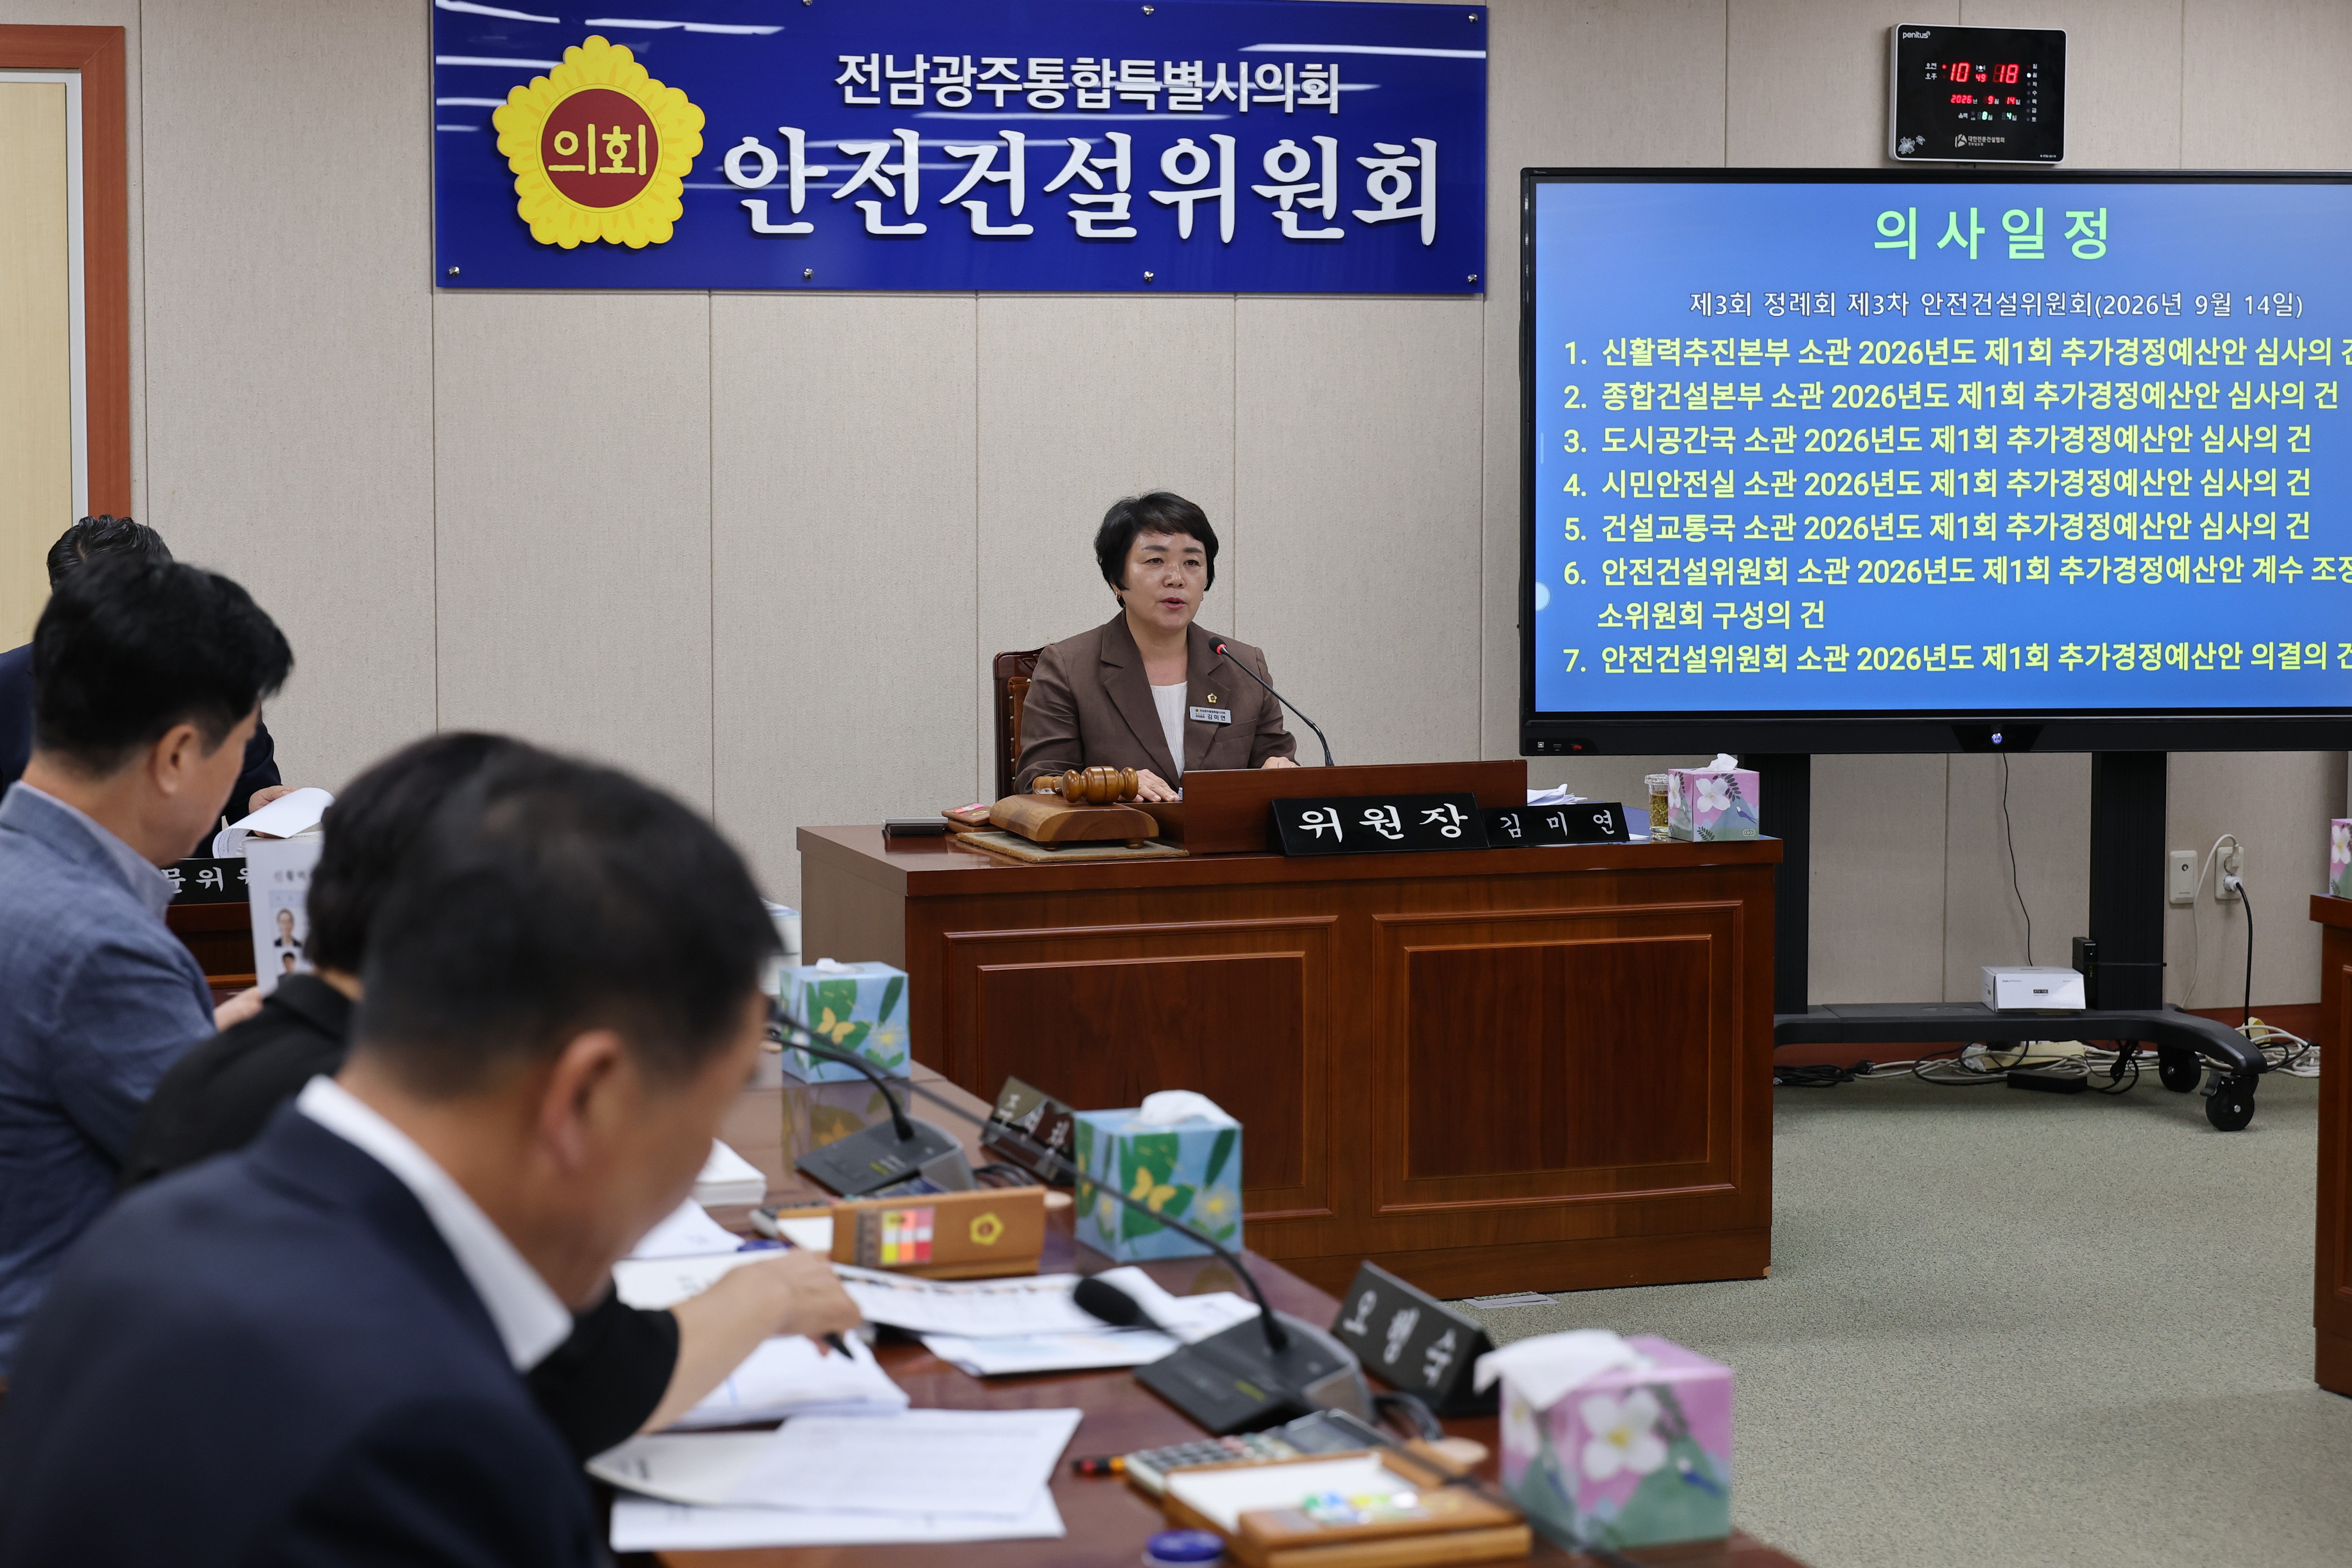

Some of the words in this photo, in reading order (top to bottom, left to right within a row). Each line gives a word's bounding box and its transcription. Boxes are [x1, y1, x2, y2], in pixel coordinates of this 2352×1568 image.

[1903, 31, 1928, 39] penitus
[834, 53, 1340, 114] 전남광주통합특별시의회
[1950, 62, 1971, 82] 10
[1975, 73, 1987, 83] 49
[1999, 64, 2019, 83] 18
[549, 123, 648, 176] 의회
[724, 126, 1438, 247] 안전건설위원회
[1874, 207, 2107, 260] 의사일정
[1690, 292, 1751, 317] 제3회
[1764, 292, 1835, 317] 정례회
[1848, 292, 1909, 317] 제3차
[1921, 292, 2181, 319] 안전건설위원회(2026년
[2195, 292, 2230, 317] 9월
[2245, 292, 2303, 319] 14일)
[1564, 341, 1587, 365] 1.
[1602, 337, 1790, 367] 신활력추진본부
[1798, 337, 1851, 366] 소관
[1859, 337, 1977, 365] 2026년도
[1984, 337, 2051, 366] 제1회
[2061, 337, 2247, 366] 추가경정예산안
[2255, 337, 2331, 366] 심사의
[1564, 385, 1587, 409] 2.
[1602, 381, 1763, 411] 종합건설본부
[1771, 381, 1824, 410] 소관
[1831, 381, 1949, 409] 2026년도
[1957, 381, 2024, 410] 제1회
[2034, 381, 2220, 410] 추가경정예산안
[2228, 381, 2304, 410] 심사의
[2314, 381, 2337, 409] 건
[1564, 429, 1587, 453] 3.
[1602, 425, 1736, 455] 도시공간국
[1744, 425, 1797, 454] 소관
[1804, 425, 1922, 453] 2026년도
[1930, 425, 1997, 454] 제1회
[2007, 425, 2193, 454] 추가경정예산안
[2201, 424, 2277, 453] 심사의
[2287, 424, 2310, 452] 건
[1563, 473, 1587, 497] 4.
[1602, 469, 1735, 498] 시민안전실
[1744, 469, 1797, 497] 소관
[1804, 469, 1922, 497] 2026년도
[1930, 468, 1996, 497] 제1회
[2006, 468, 2192, 497] 추가경정예산안
[2200, 468, 2276, 497] 심사의
[2287, 468, 2310, 496] 건
[1564, 517, 1587, 541] 5.
[1602, 514, 1736, 543] 건설교통국
[1744, 513, 1797, 541] 소관
[1804, 513, 1922, 541] 2026년도
[1929, 512, 1996, 541] 제1회
[2006, 512, 2192, 541] 추가경정예산안
[2200, 511, 2276, 540] 심사의
[2286, 511, 2309, 539] 건
[1564, 561, 1586, 585] 6.
[1602, 557, 1787, 586] 안전건설위원회
[1797, 556, 1850, 584] 소관
[1857, 556, 1975, 584] 2026년도
[1983, 555, 2049, 584] 제1회
[2059, 555, 2245, 584] 추가경정예산안
[2252, 555, 2303, 584] 계수
[1597, 601, 1702, 630] 소위원회
[1712, 600, 1789, 630] 구성의
[1800, 600, 1824, 628] 건
[1563, 648, 1586, 672] 7.
[1602, 644, 1786, 673] 안전건설위원회
[1797, 644, 1850, 672] 소관
[1857, 643, 1974, 671] 2026년도
[1982, 643, 2048, 671] 제1회
[2058, 642, 2243, 671] 추가경정예산안
[2250, 641, 2327, 670] 의결의
[1298, 803, 1468, 843] 위원장
[1500, 809, 1615, 839] 김미연
